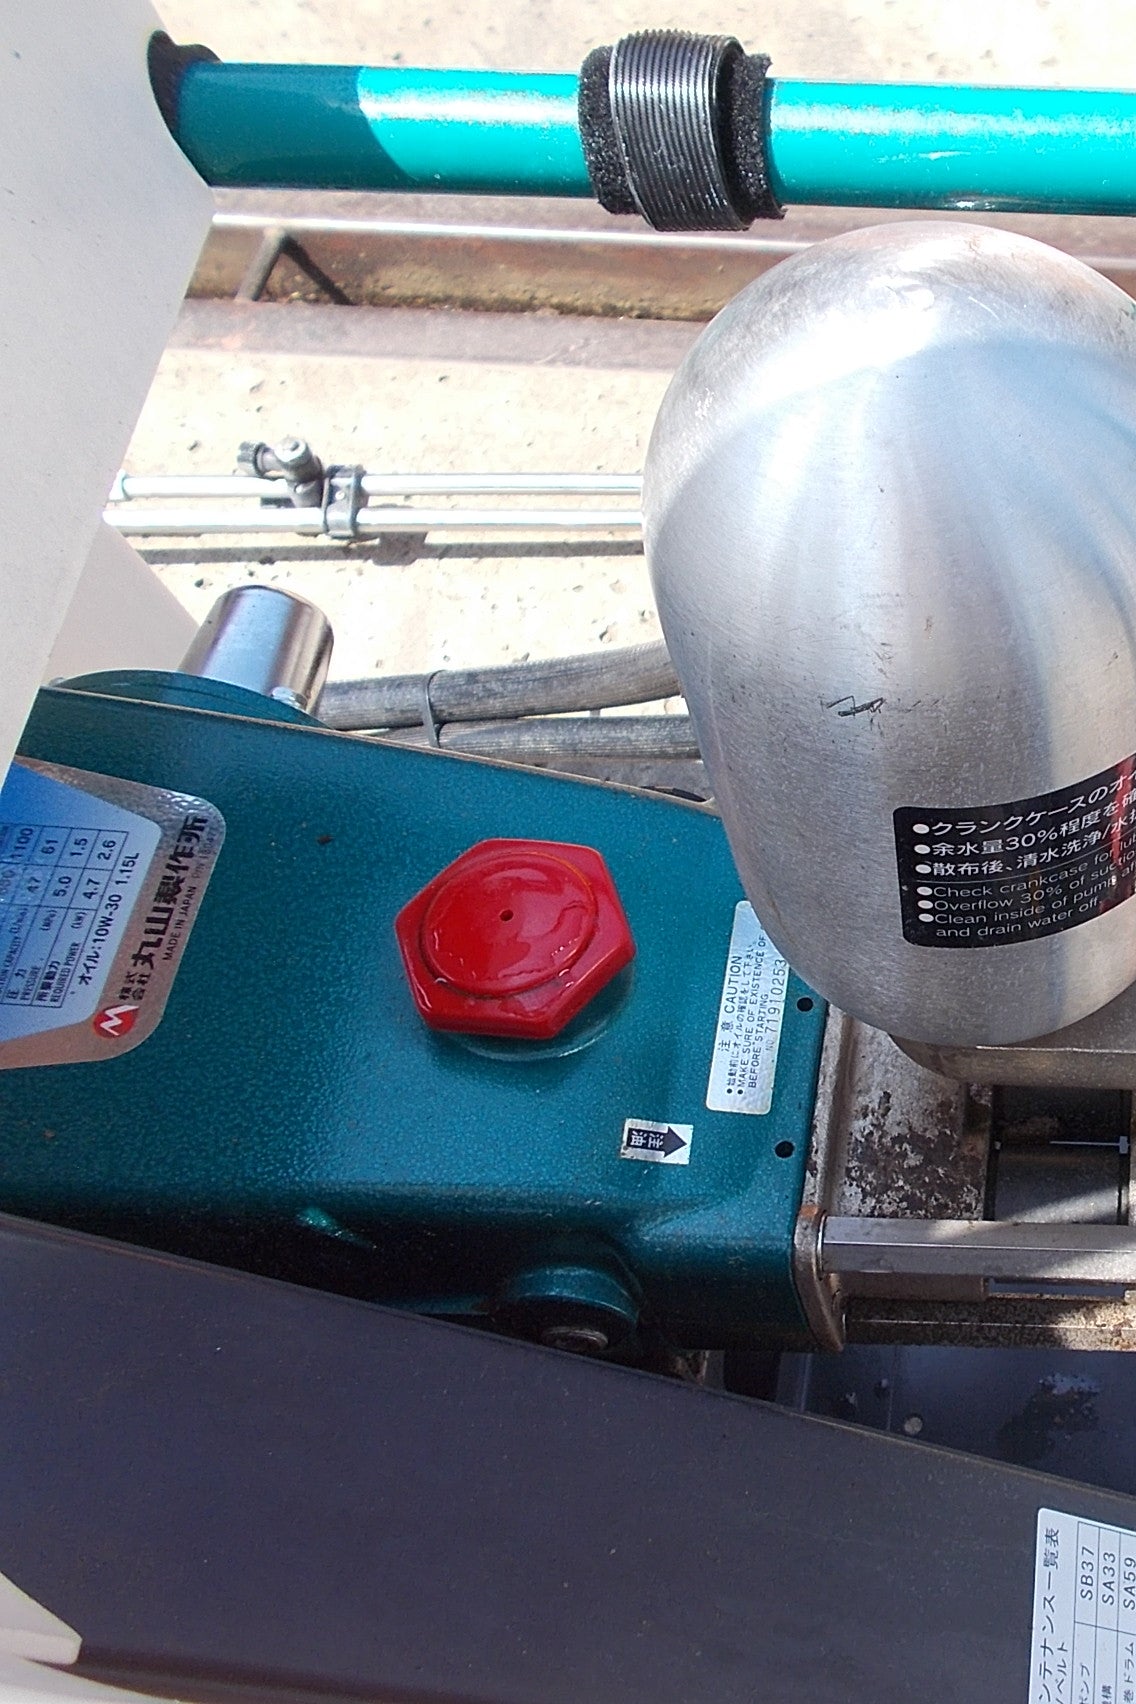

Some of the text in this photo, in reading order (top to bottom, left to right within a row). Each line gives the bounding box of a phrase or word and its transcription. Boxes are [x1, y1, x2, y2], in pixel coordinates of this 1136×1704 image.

[10, 828, 33, 859] 1100
[41, 840, 58, 854] 61
[54, 876, 72, 897] 5.0
[70, 838, 88, 856] 1.5
[83, 878, 101, 899] 4.7
[98, 839, 116, 861] 2.6
[117, 851, 140, 885] 1.15L
[132, 815, 208, 969] 丸山製作所
[933, 885, 993, 898] Check
[999, 861, 1089, 893] crankcase
[1094, 848, 1113, 866] for
[934, 897, 1014, 911] Overflow
[1020, 884, 1062, 904] 30%
[1069, 875, 1085, 890] of
[934, 912, 987, 924] Clean
[994, 904, 1046, 921] inside
[1051, 896, 1069, 910] of
[1073, 876, 1118, 902] pump
[163, 886, 197, 961] MADE IN JAPAN
[936, 926, 970, 937] and
[977, 922, 1022, 936] drain
[1028, 908, 1073, 928] water
[723, 955, 743, 1014] CAUTION
[737, 933, 767, 1088] MAKE SURE OF EXISTENCE OF
[764, 959, 787, 1033] 71910253
[747, 993, 769, 1089] BEFORE STARTING
[1080, 1545, 1095, 1601] SB37
[1101, 1551, 1116, 1606] SA33
[1122, 1557, 1136, 1610] SA59
